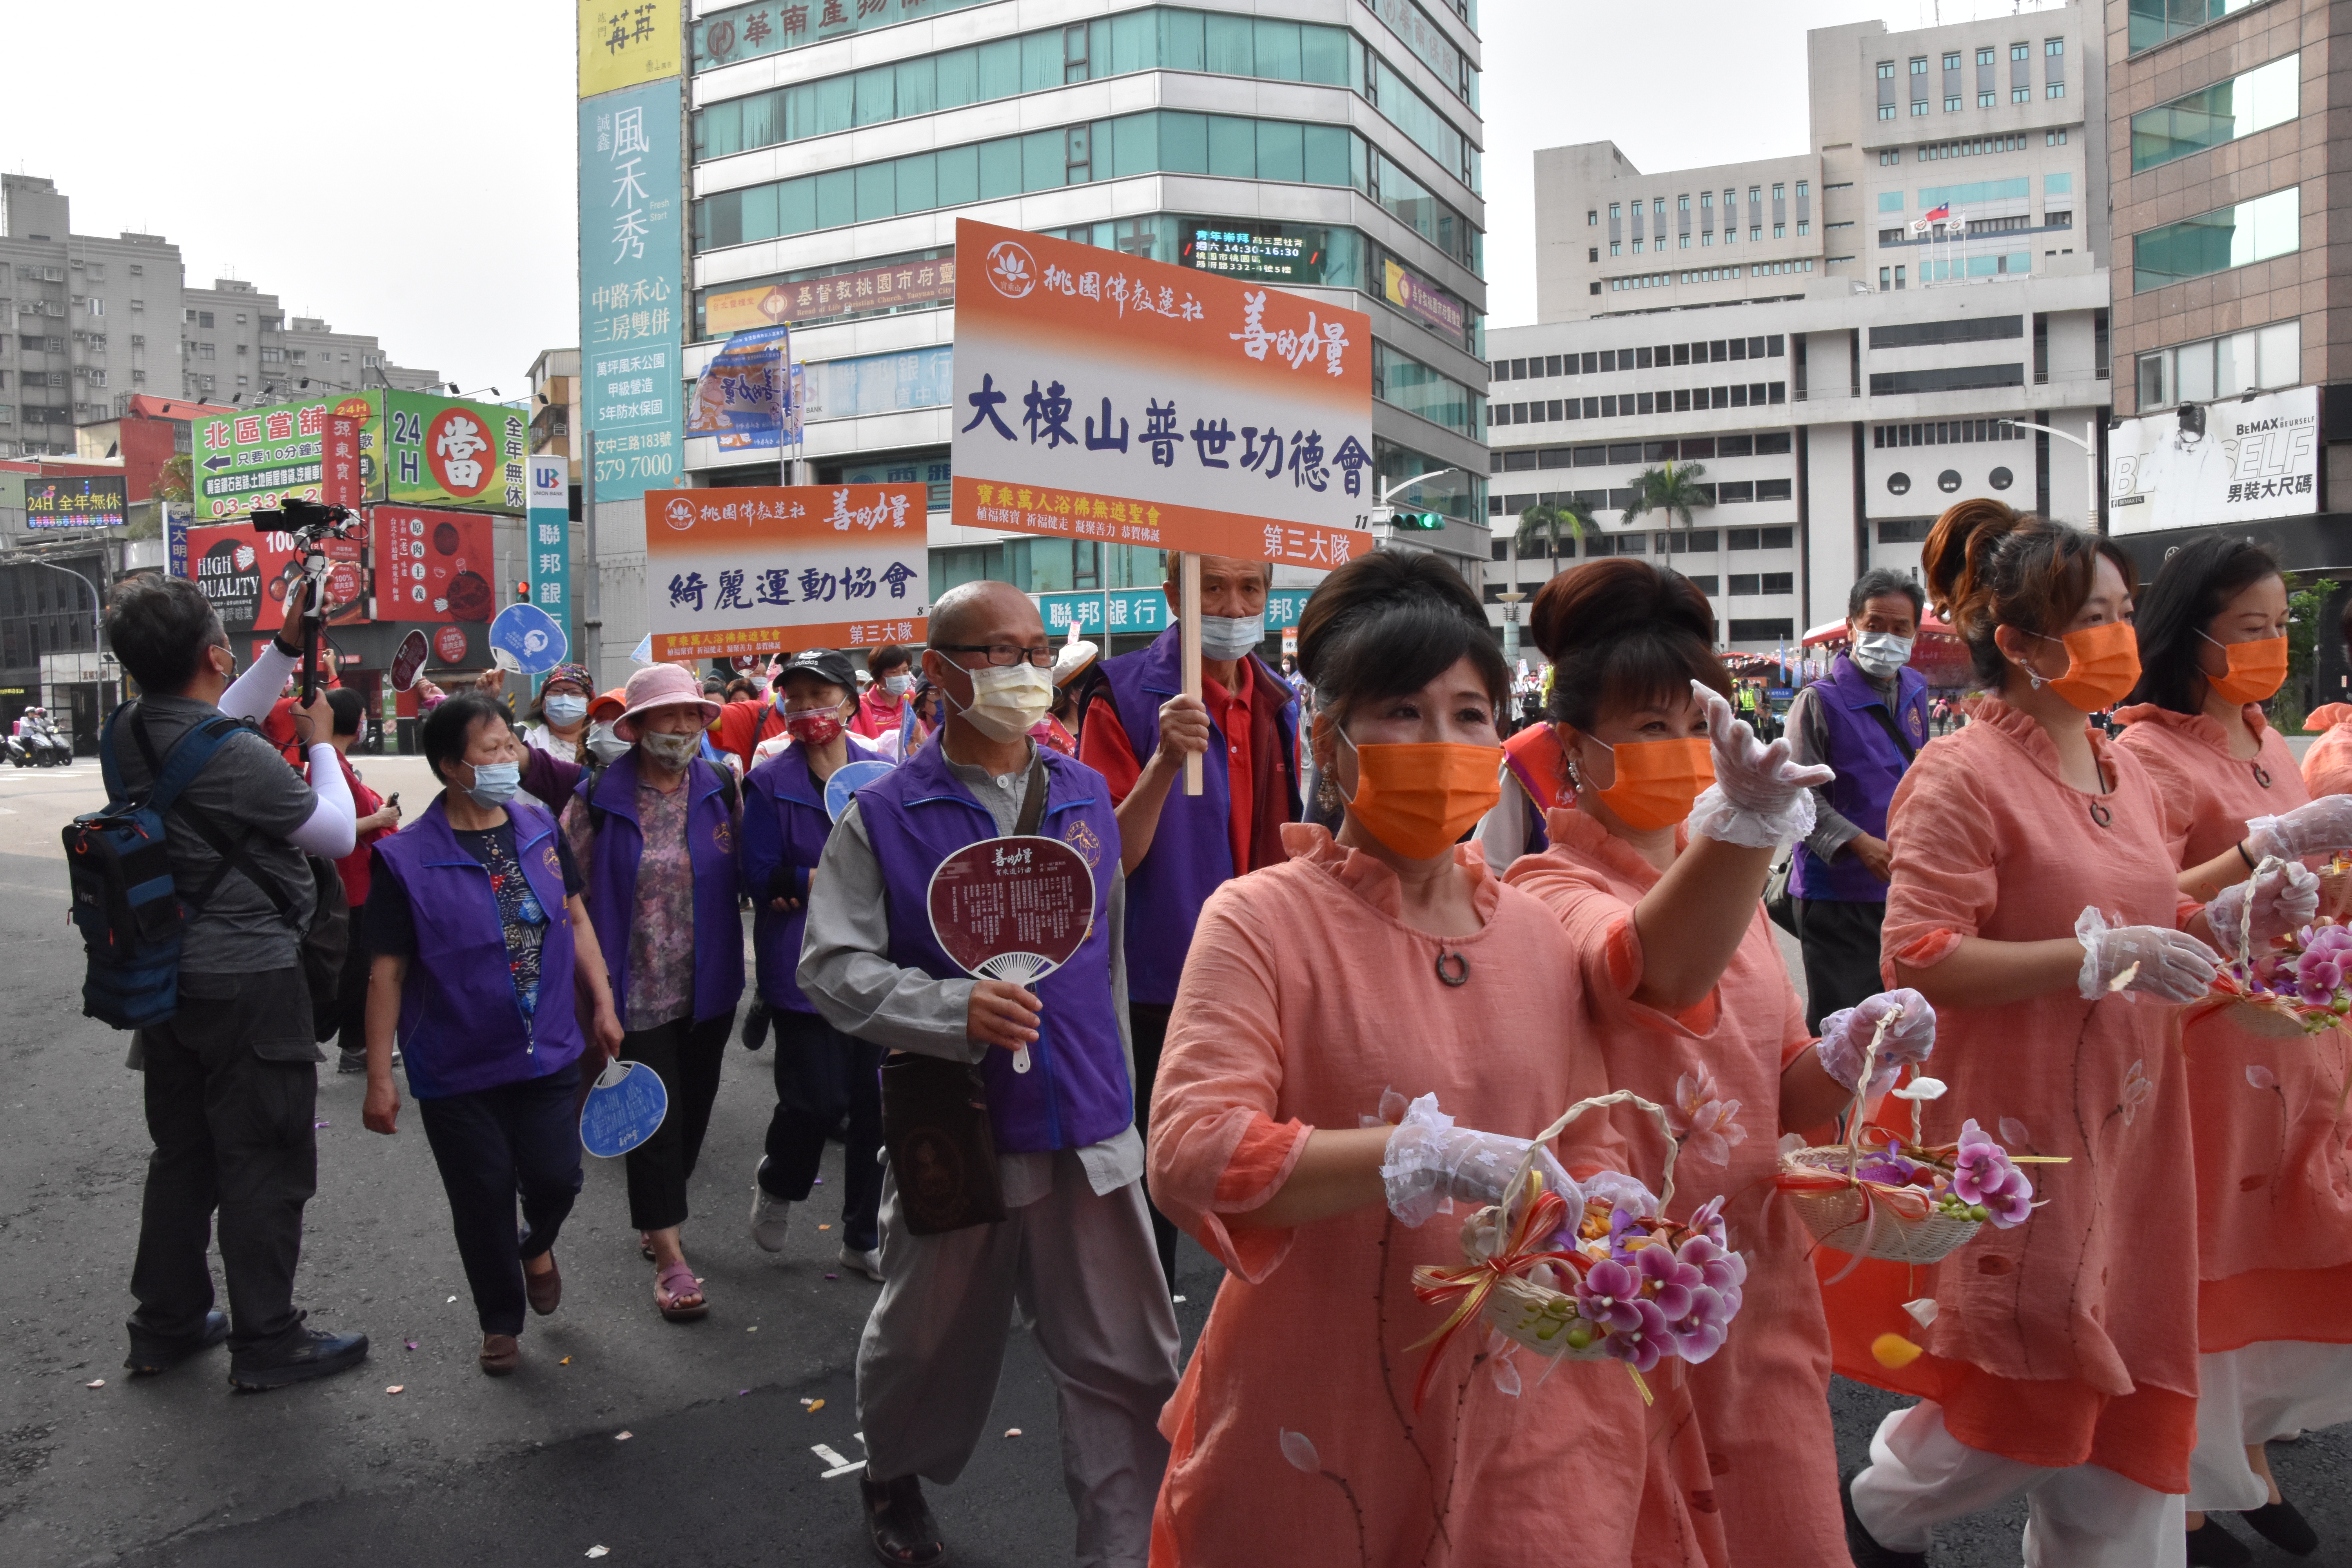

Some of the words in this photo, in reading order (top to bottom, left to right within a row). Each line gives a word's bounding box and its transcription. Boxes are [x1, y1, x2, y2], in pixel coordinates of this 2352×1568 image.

[743, 0, 929, 48] 華南產物
[596, 115, 611, 152] 誠鑫
[610, 106, 649, 265] 風禾秀
[650, 199, 670, 210] Fresh
[650, 212, 668, 221] Start
[1196, 230, 1249, 243] 青年崇拜
[1224, 244, 1299, 257] 14:30-16:30
[592, 276, 671, 314] 中路禾心
[797, 262, 955, 306] 基督教桃園市府靈
[1000, 281, 1021, 292] 寶乘山
[1043, 263, 1205, 322] 桃園佛教蓮社
[592, 307, 671, 343] 三房雙併
[1229, 290, 1349, 378] 善的力量
[596, 353, 665, 377] 萬坪風禾公園
[608, 378, 653, 397] 甲級營造
[337, 403, 367, 415] 24H
[599, 399, 663, 421] 5年防水保固
[806, 406, 823, 414] BANK
[2280, 416, 2315, 429] BEURSELF
[393, 410, 422, 446] 24
[594, 430, 672, 455] 文中三路183號
[960, 373, 1373, 499] 大棟山普世功德會
[436, 416, 488, 488] 當
[504, 416, 524, 508] 全年無休
[399, 450, 420, 485] H
[594, 459, 626, 483] 379
[630, 453, 672, 477] 7000
[27, 496, 54, 511] 24H
[58, 492, 122, 511] 全年無休
[2227, 474, 2313, 503] 男裝大尺碼
[700, 500, 806, 527] 桃園佛教蓮社
[823, 488, 911, 532] 善的力量
[976, 483, 1161, 527] 寶乘萬人浴佛無遮聖會
[976, 506, 1020, 526] 植福聚寶
[1026, 510, 1069, 532] 祈福健走
[1074, 517, 1116, 538] 凝聚善力
[1121, 524, 1160, 543] 恭賀佛誕
[1355, 514, 1368, 529] 11
[1263, 523, 1351, 564] 第三大隊
[198, 555, 232, 576] HIGH
[412, 521, 424, 600] 原肉主義
[199, 576, 260, 599] QUALITY
[335, 574, 353, 582] 100%
[668, 561, 918, 612] 綺麗運動協會
[917, 606, 924, 616] 8
[1050, 597, 1156, 628] 聯邦銀行
[850, 622, 913, 644] 第三大隊
[991, 847, 1033, 866] 善的力量
